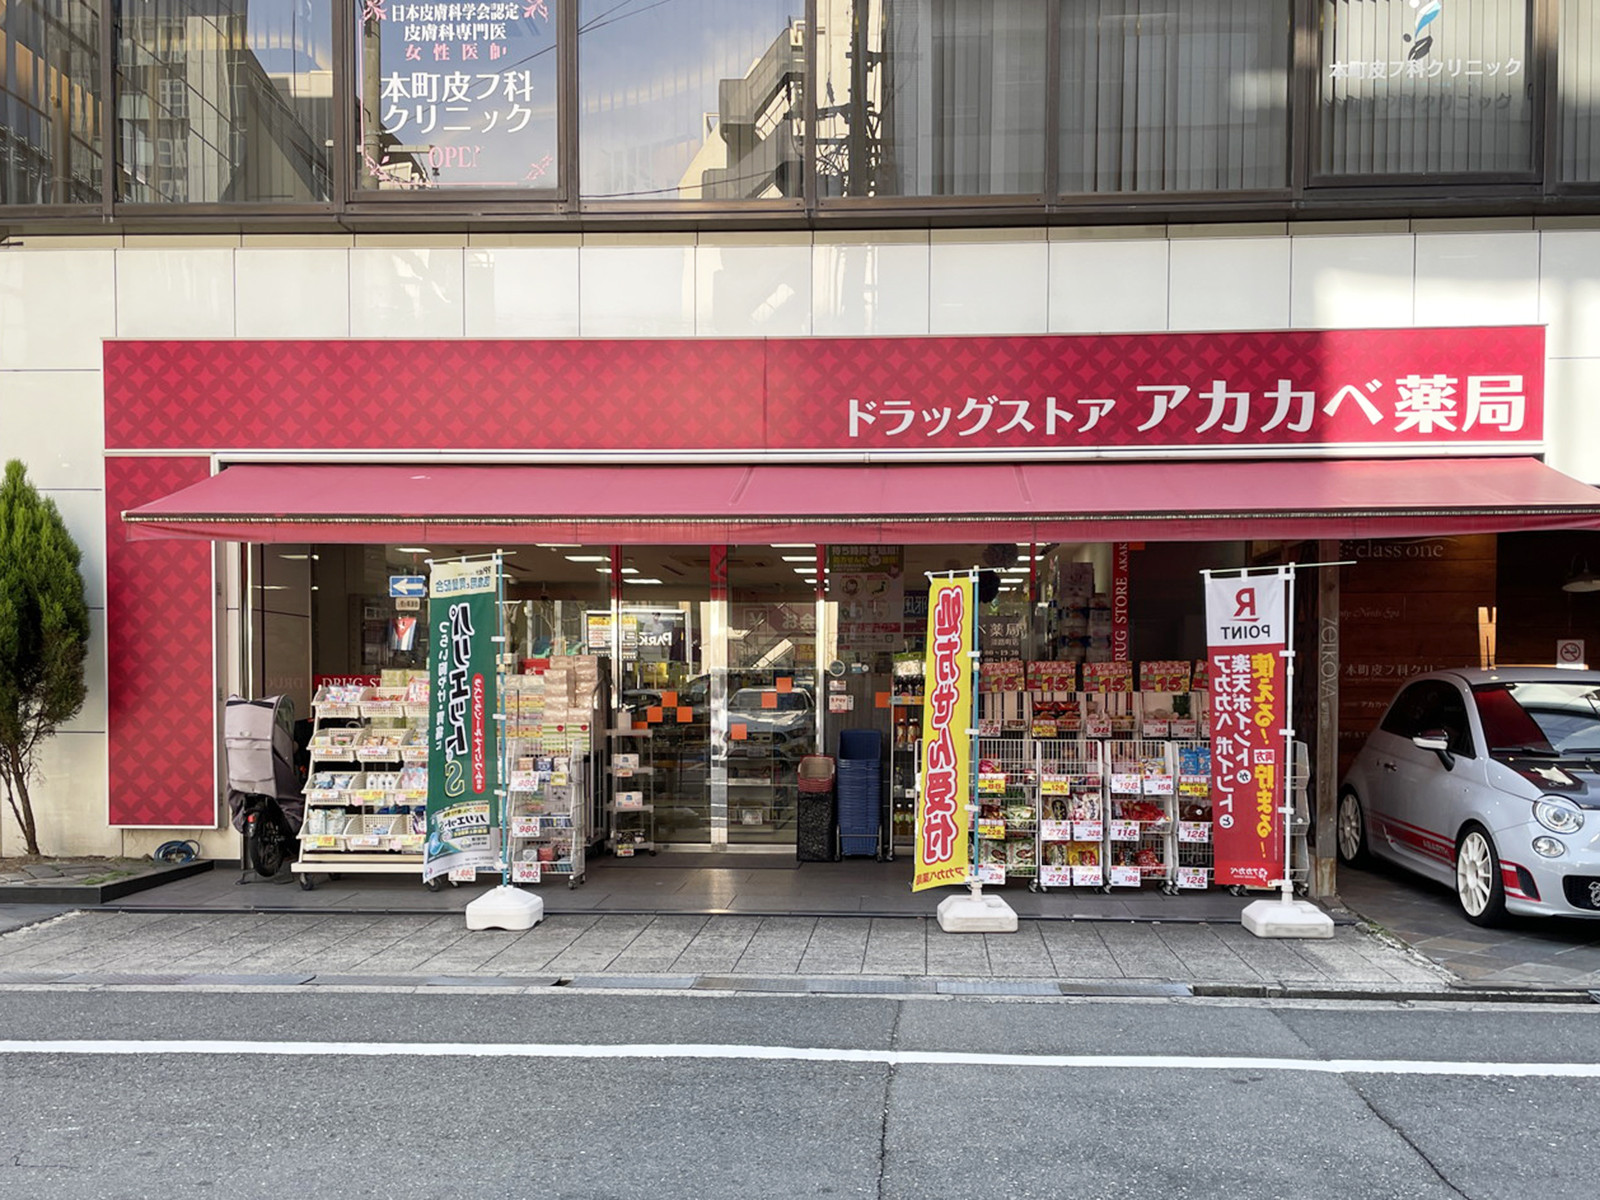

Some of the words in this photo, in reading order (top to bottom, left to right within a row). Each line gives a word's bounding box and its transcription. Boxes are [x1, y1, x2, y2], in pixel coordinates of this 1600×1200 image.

[391, 4, 520, 22] 日本皮膚科学会認定
[404, 23, 507, 42] 皮膚科専門医
[1328, 58, 1522, 79] 本町皮フ科クリニック
[381, 71, 534, 103] 本町皮フ科
[383, 104, 533, 134] クリニック
[848, 396, 1115, 438] ドラッグストア
[1135, 373, 1526, 435] アカカベ薬局
[1355, 541, 1402, 558] class
[1406, 544, 1444, 558] one
[1114, 576, 1127, 624] STORE
[1114, 630, 1127, 662] RUG
[519, 825, 538, 833] 980
[1117, 829, 1137, 837] 118
[1187, 830, 1206, 838] 128
[520, 871, 539, 879] 980
[1048, 874, 1068, 882] 278
[1186, 876, 1205, 884] 128
